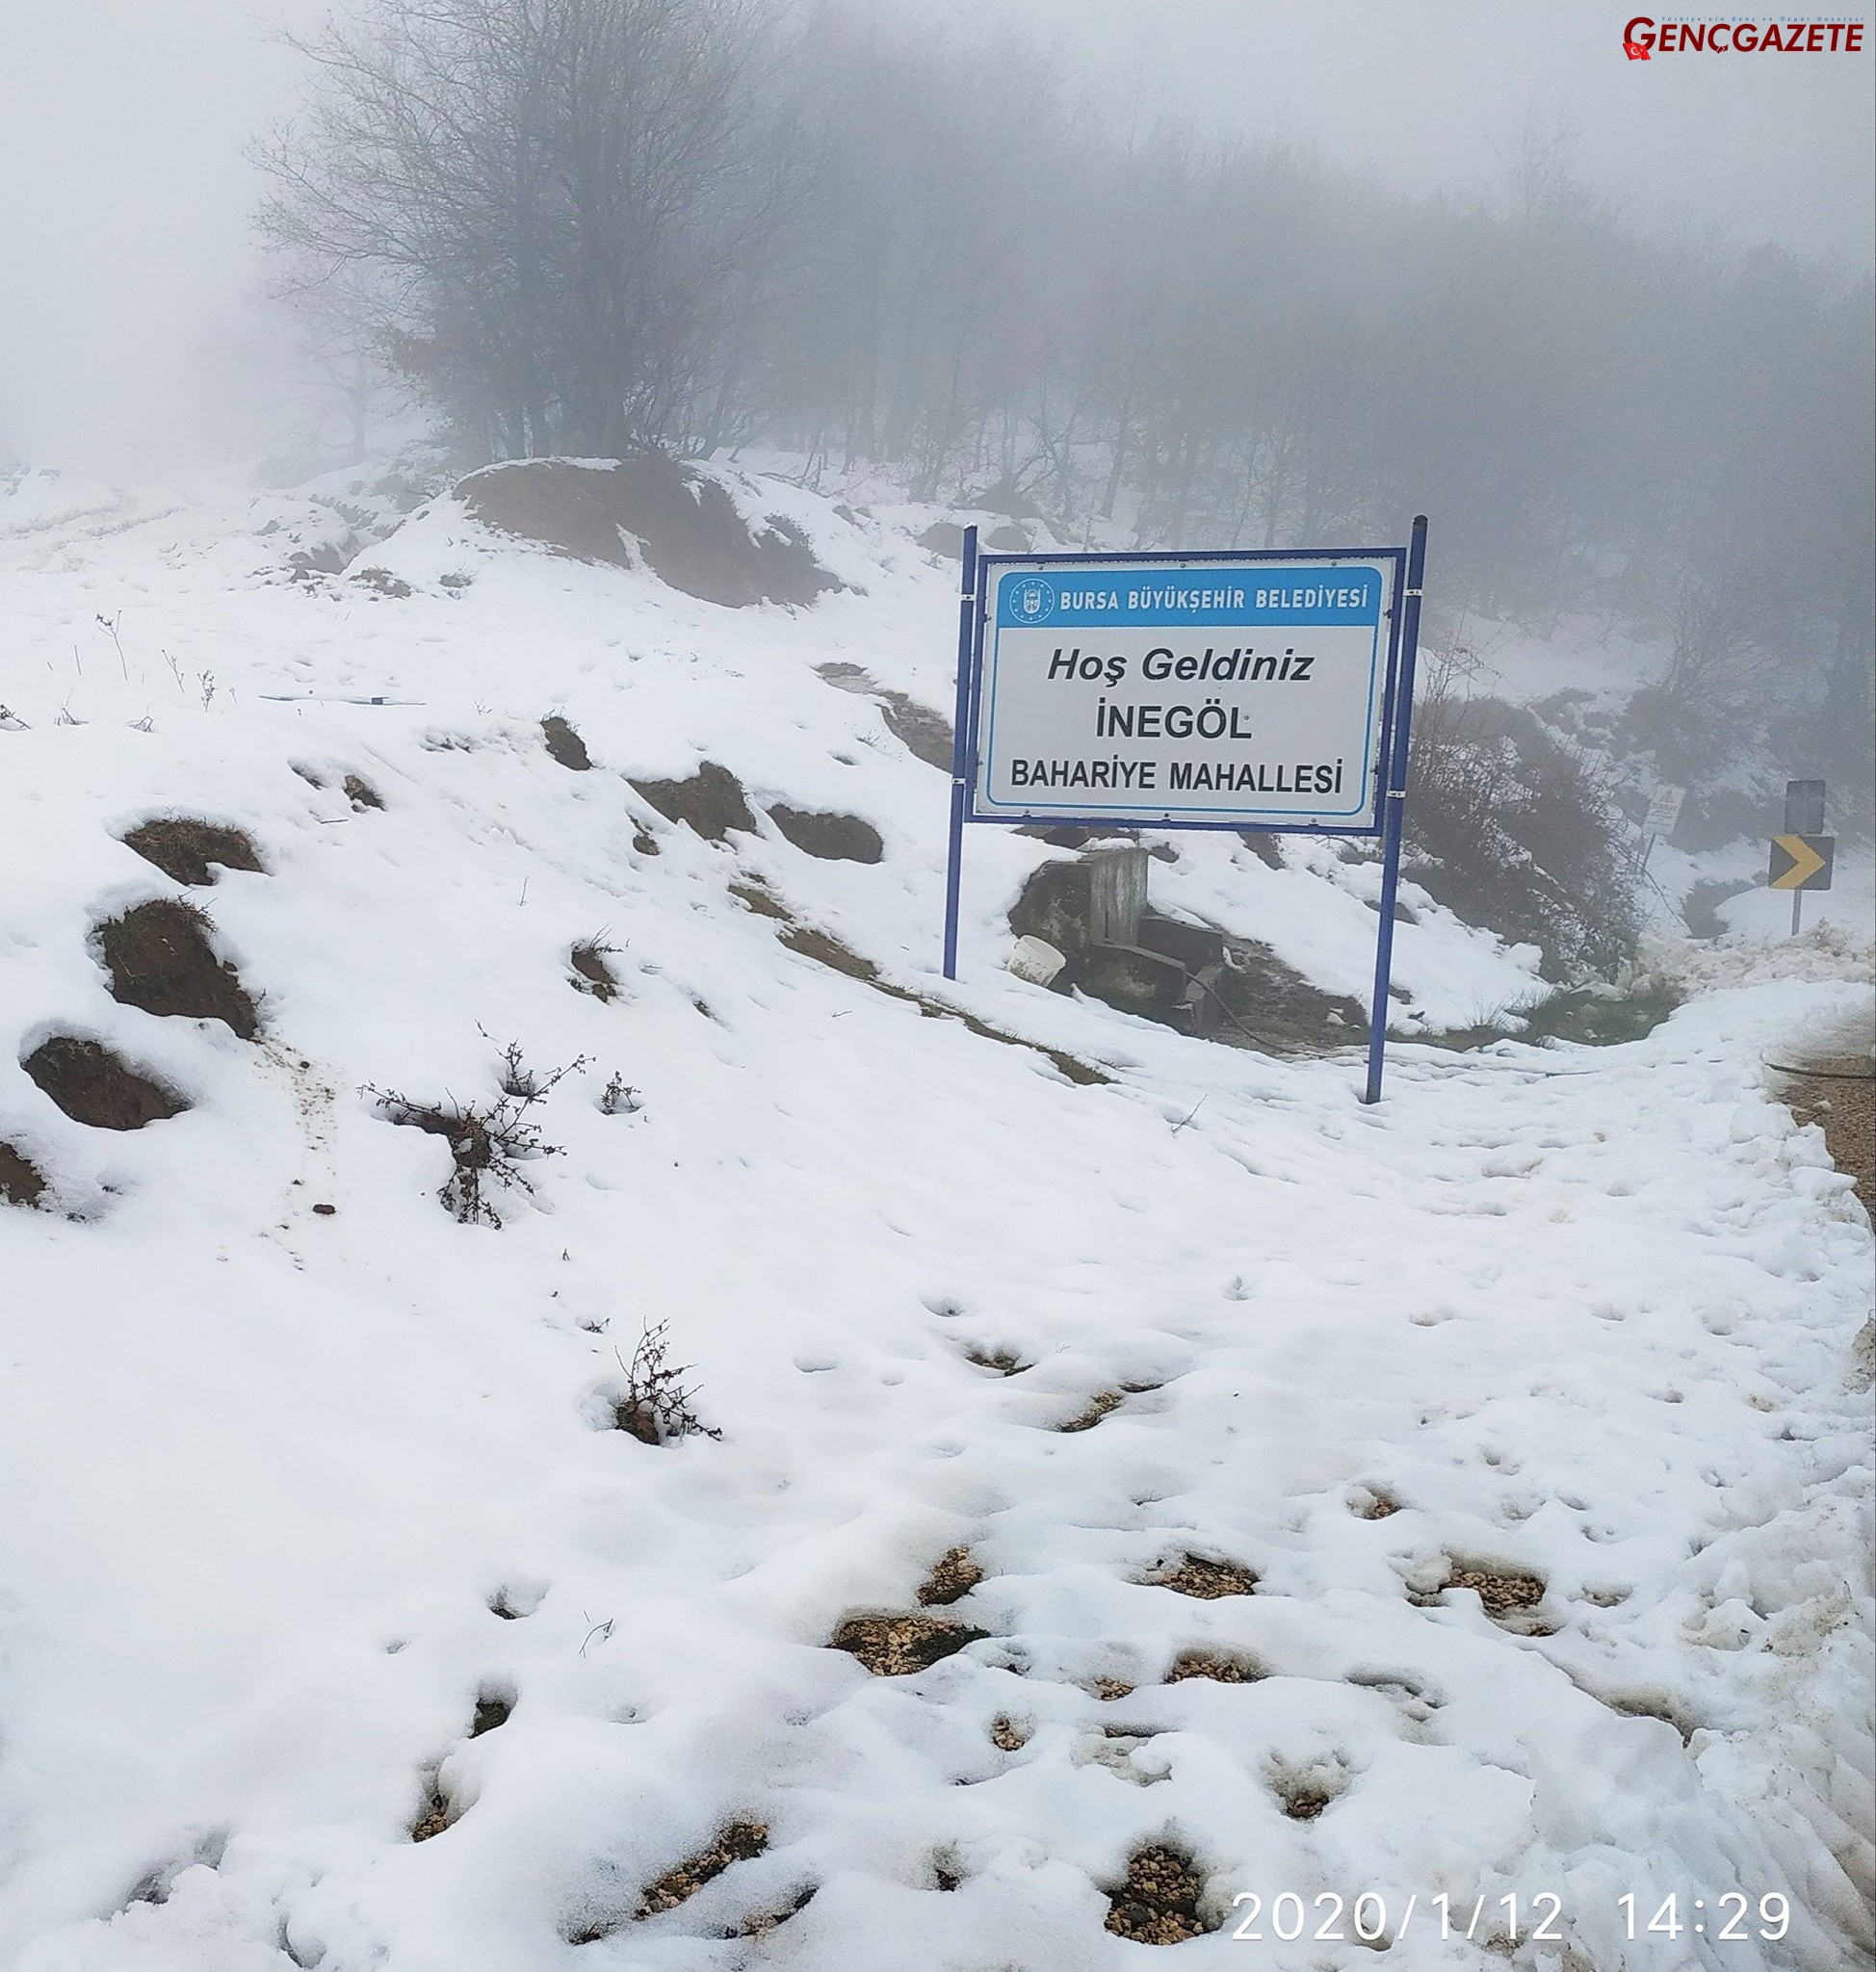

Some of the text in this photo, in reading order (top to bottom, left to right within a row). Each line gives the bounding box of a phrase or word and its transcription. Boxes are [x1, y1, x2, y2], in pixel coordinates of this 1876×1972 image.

[1059, 584, 1368, 613] BURSA BÜYÜKŞEHİR BELEDİYESİ
[1047, 647, 1316, 687] Hoş Geldiniz
[1096, 697, 1252, 739] İNEGÖL
[1010, 754, 1343, 793] BAHARİYE MAHALLESİ
